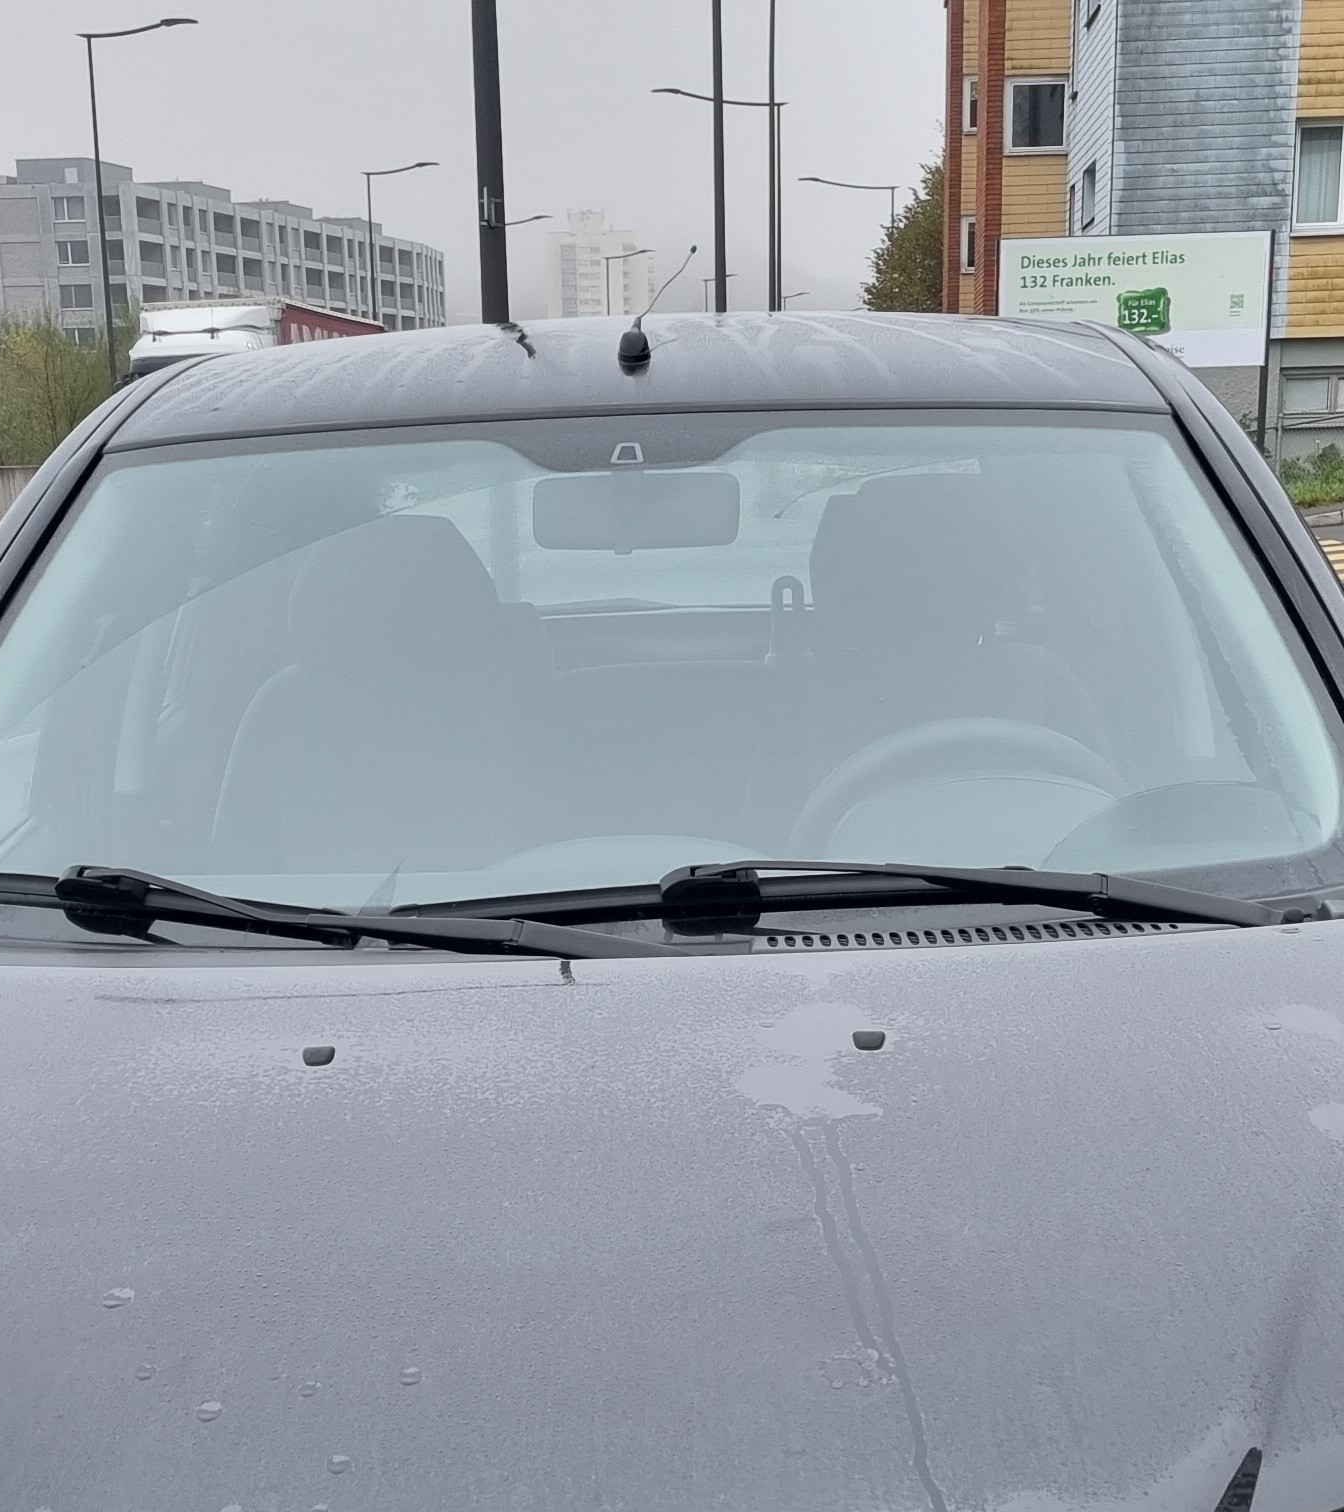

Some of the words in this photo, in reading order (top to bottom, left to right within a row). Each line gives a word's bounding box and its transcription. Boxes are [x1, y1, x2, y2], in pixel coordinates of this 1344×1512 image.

[1020, 255, 1068, 269] Dieses
[1071, 253, 1103, 268] Jahr
[1107, 252, 1148, 266] feiert
[1152, 250, 1185, 265] Elias
[1020, 275, 1048, 289] 132
[1052, 272, 1116, 288] Franken.
[1128, 299, 1140, 307] Für
[1140, 298, 1156, 306] Elias
[1123, 308, 1159, 325] 132.-
